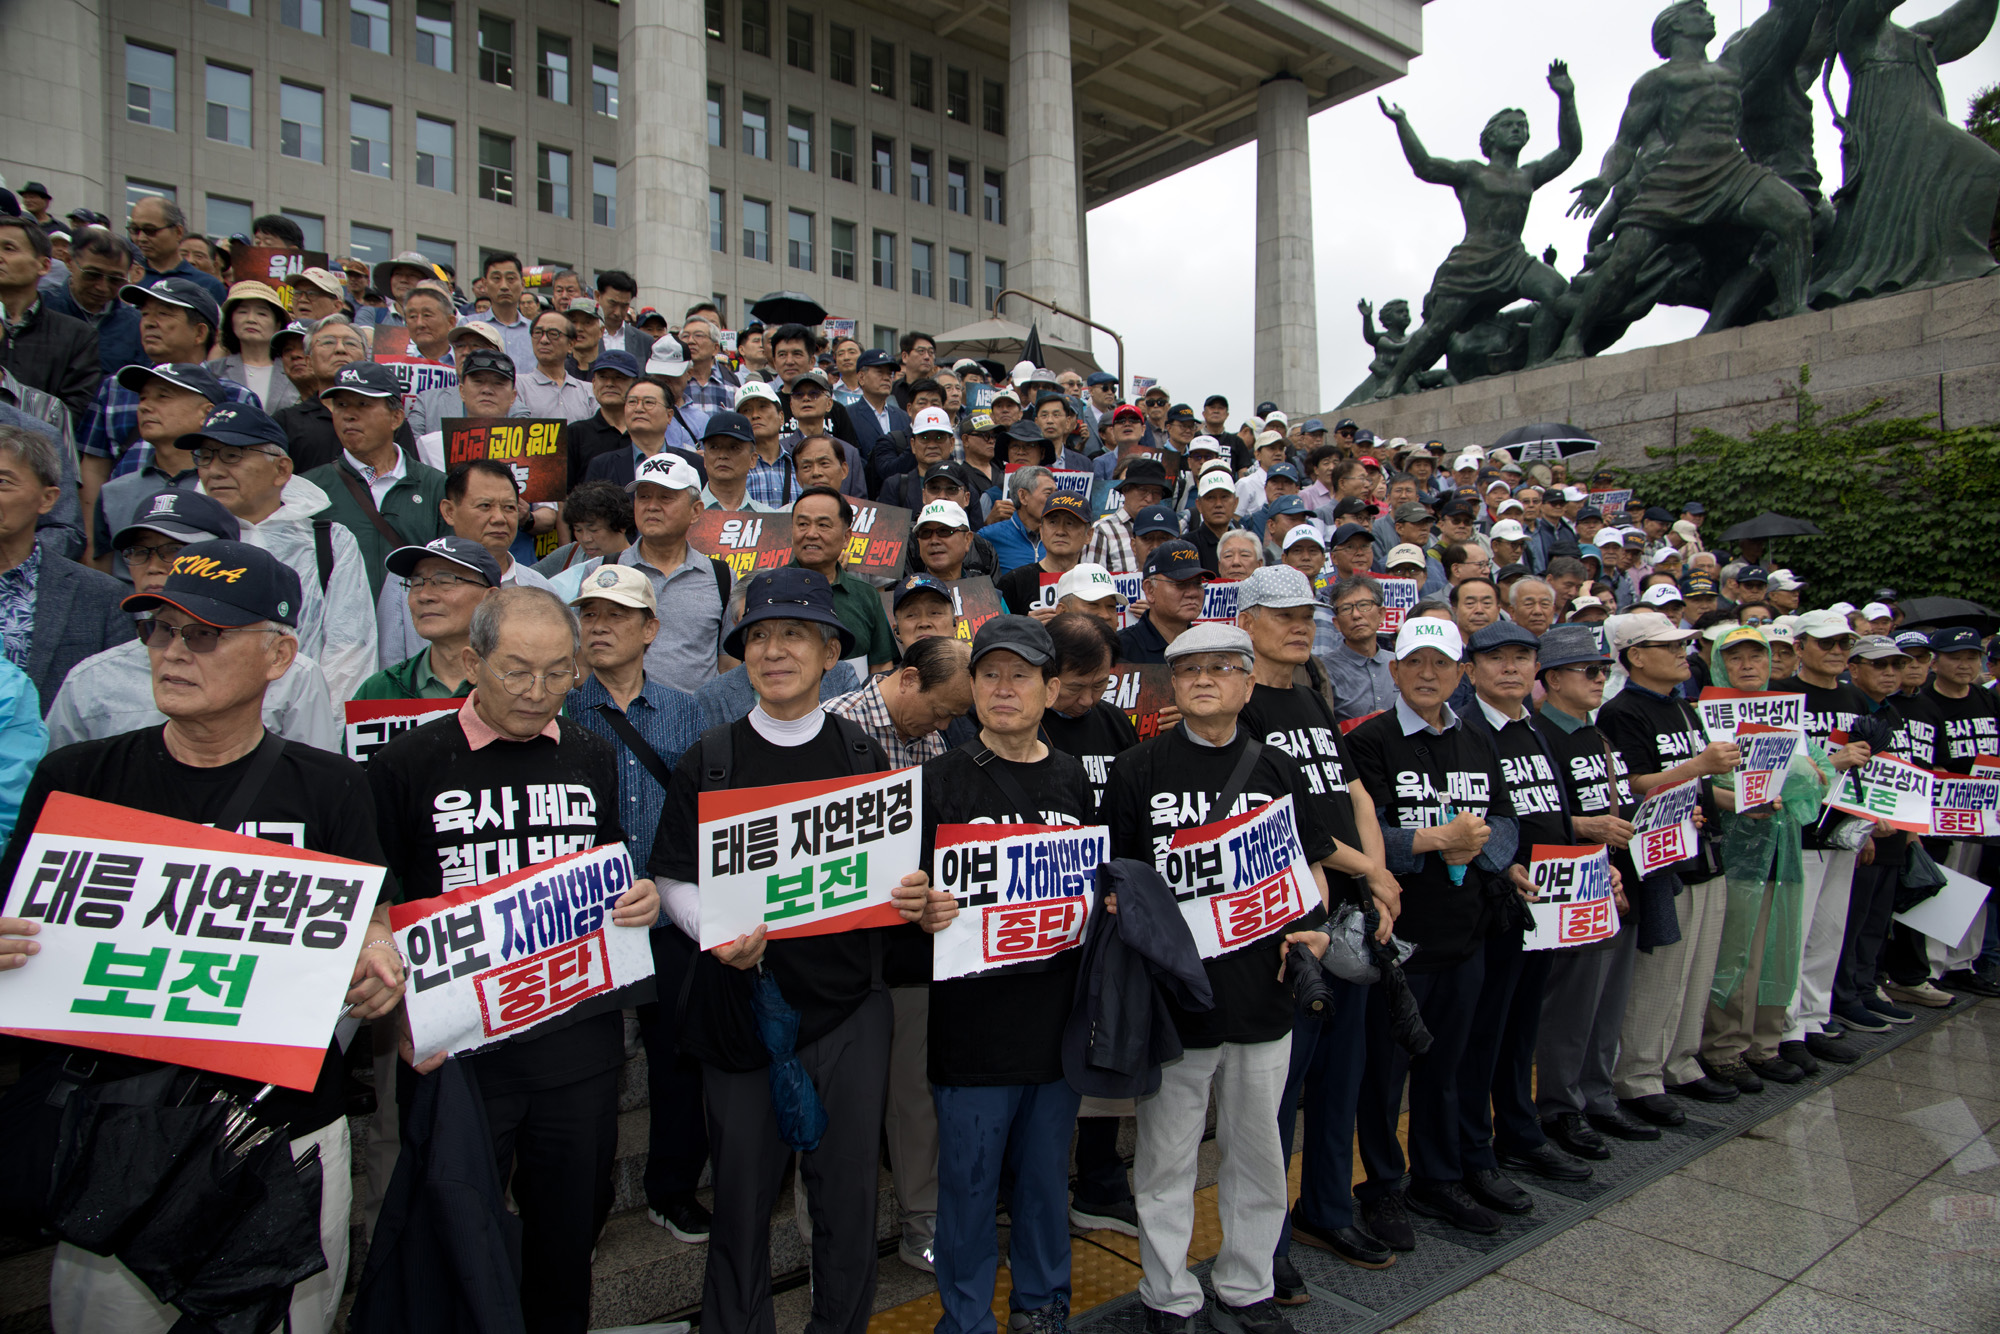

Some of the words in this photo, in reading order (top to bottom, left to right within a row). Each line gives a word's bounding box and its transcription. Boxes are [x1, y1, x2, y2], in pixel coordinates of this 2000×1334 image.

[268, 254, 303, 281] 육사
[742, 385, 760, 396] KMA
[488, 425, 524, 460] 이전
[643, 460, 676, 475] PXG
[1208, 477, 1224, 485] KMA
[925, 505, 945, 516] KMA
[1052, 496, 1083, 508] KMA
[719, 518, 763, 549] 육사
[850, 505, 878, 534] 사
[1295, 528, 1313, 536] KMA
[866, 539, 902, 567] 반대
[1172, 550, 1199, 561] KMA
[169, 555, 247, 583] KMA
[1091, 573, 1112, 585] KMA
[1201, 585, 1239, 618] 자해행
[1382, 582, 1416, 608] 해행위
[1415, 624, 1444, 636] KMA
[1704, 703, 1735, 729] 태릉
[1737, 699, 1800, 727] 안보성지
[1836, 711, 1859, 733] 폐
[1972, 717, 1999, 735] 폐교
[1266, 728, 1311, 759] 육사
[1656, 731, 1690, 756] 육사
[1749, 736, 1798, 771] 자해행위
[1501, 755, 1535, 785] 육사
[1531, 753, 1555, 782] 폐
[1570, 753, 1608, 782] 육사
[1861, 759, 1928, 797] 안보성지
[1446, 771, 1490, 802] 폐교
[1541, 784, 1562, 812] 반
[1745, 774, 1767, 801] 중단
[1840, 781, 1898, 816] 보존
[1944, 782, 1999, 811] 자해행위
[432, 786, 520, 834] 육사
[526, 783, 597, 827] 폐교
[1151, 791, 1211, 827] 육사
[1652, 784, 1697, 830] 자해행위
[1940, 811, 1977, 832] 중단
[712, 815, 779, 877] 태릉
[791, 779, 913, 860] 자연환경
[1166, 842, 1225, 902] 안보
[1229, 804, 1302, 890] 자해행위
[1646, 828, 1678, 863] 중단
[438, 838, 519, 893] 절대
[942, 845, 998, 909] 안보
[1006, 836, 1104, 902] 자해행위
[764, 851, 868, 922] 보전
[1533, 861, 1575, 904] 안보
[19, 850, 144, 929] 태릉
[142, 862, 364, 949] 자연환경
[1229, 876, 1290, 937] 중단
[407, 904, 491, 994] 안보
[494, 853, 633, 961] 자해행위
[996, 904, 1076, 953] 중단
[1568, 903, 1609, 937] 중단
[69, 941, 260, 1027] 보전
[498, 942, 592, 1022] 중단
